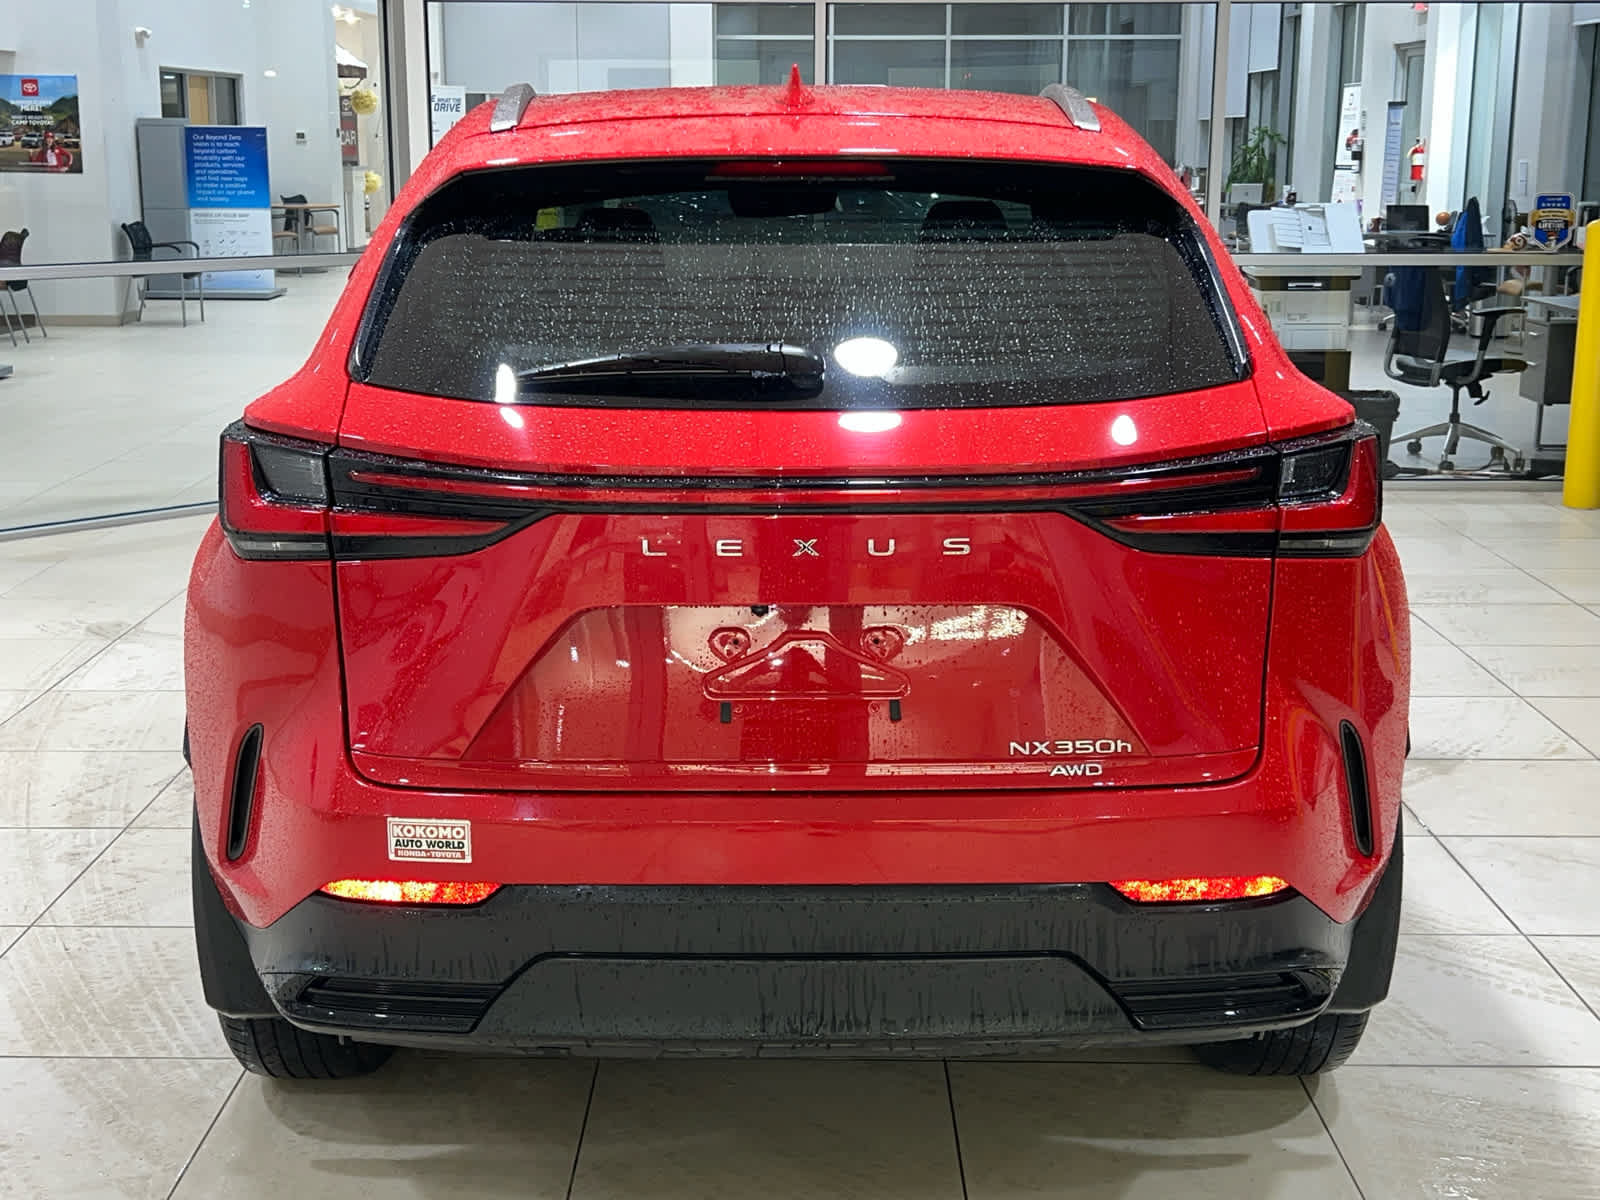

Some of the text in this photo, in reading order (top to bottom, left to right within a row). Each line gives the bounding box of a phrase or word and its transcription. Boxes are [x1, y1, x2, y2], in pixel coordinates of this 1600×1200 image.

[434, 103, 461, 112] DRIVE
[642, 538, 971, 557] LEXUS
[1050, 763, 1102, 776] AWD
[393, 825, 465, 839] KOKOMO
[395, 839, 465, 849] AUTO WORLD
